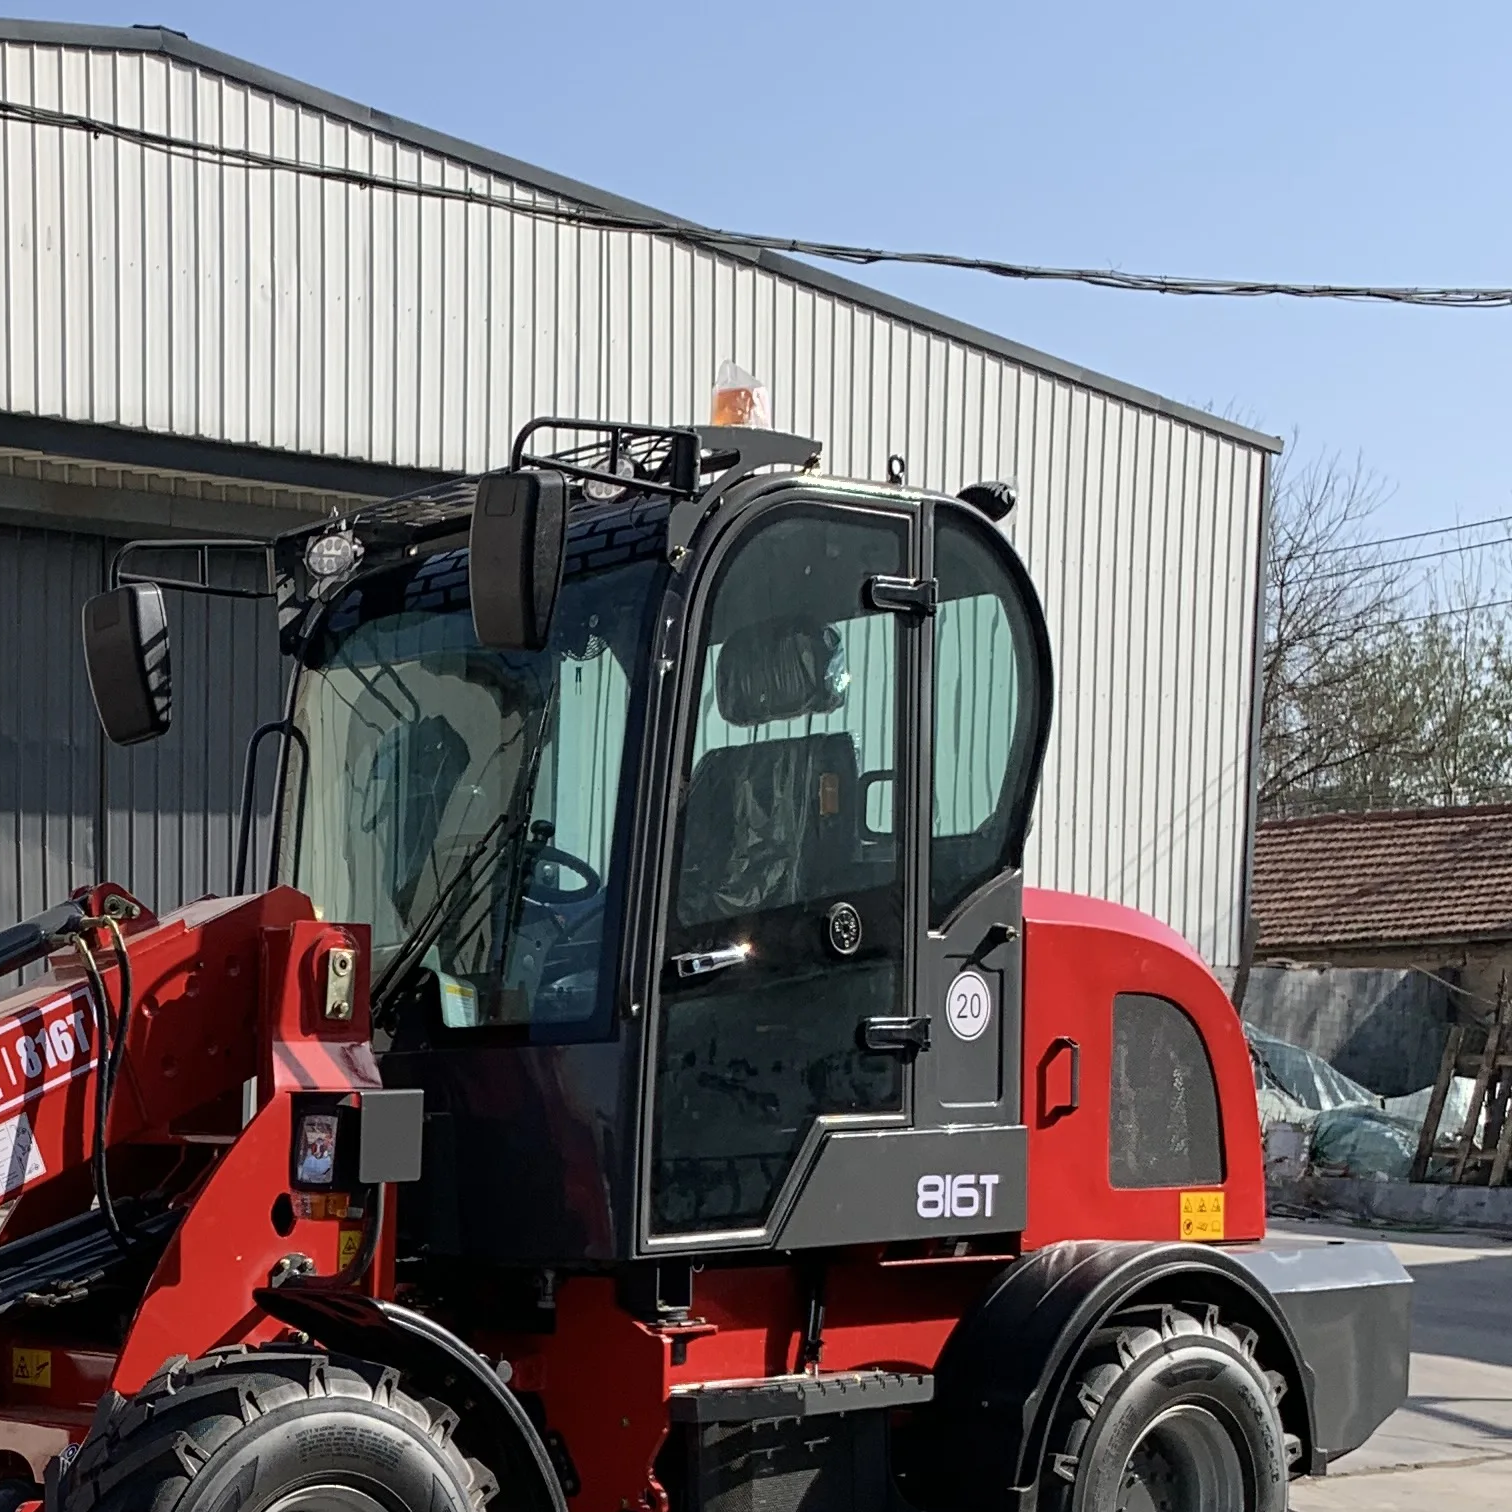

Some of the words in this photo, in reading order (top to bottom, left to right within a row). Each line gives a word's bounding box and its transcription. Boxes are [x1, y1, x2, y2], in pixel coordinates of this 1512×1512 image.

[956, 993, 982, 1019] 20
[15, 1010, 90, 1078] 816T
[916, 1174, 999, 1218] 816T
